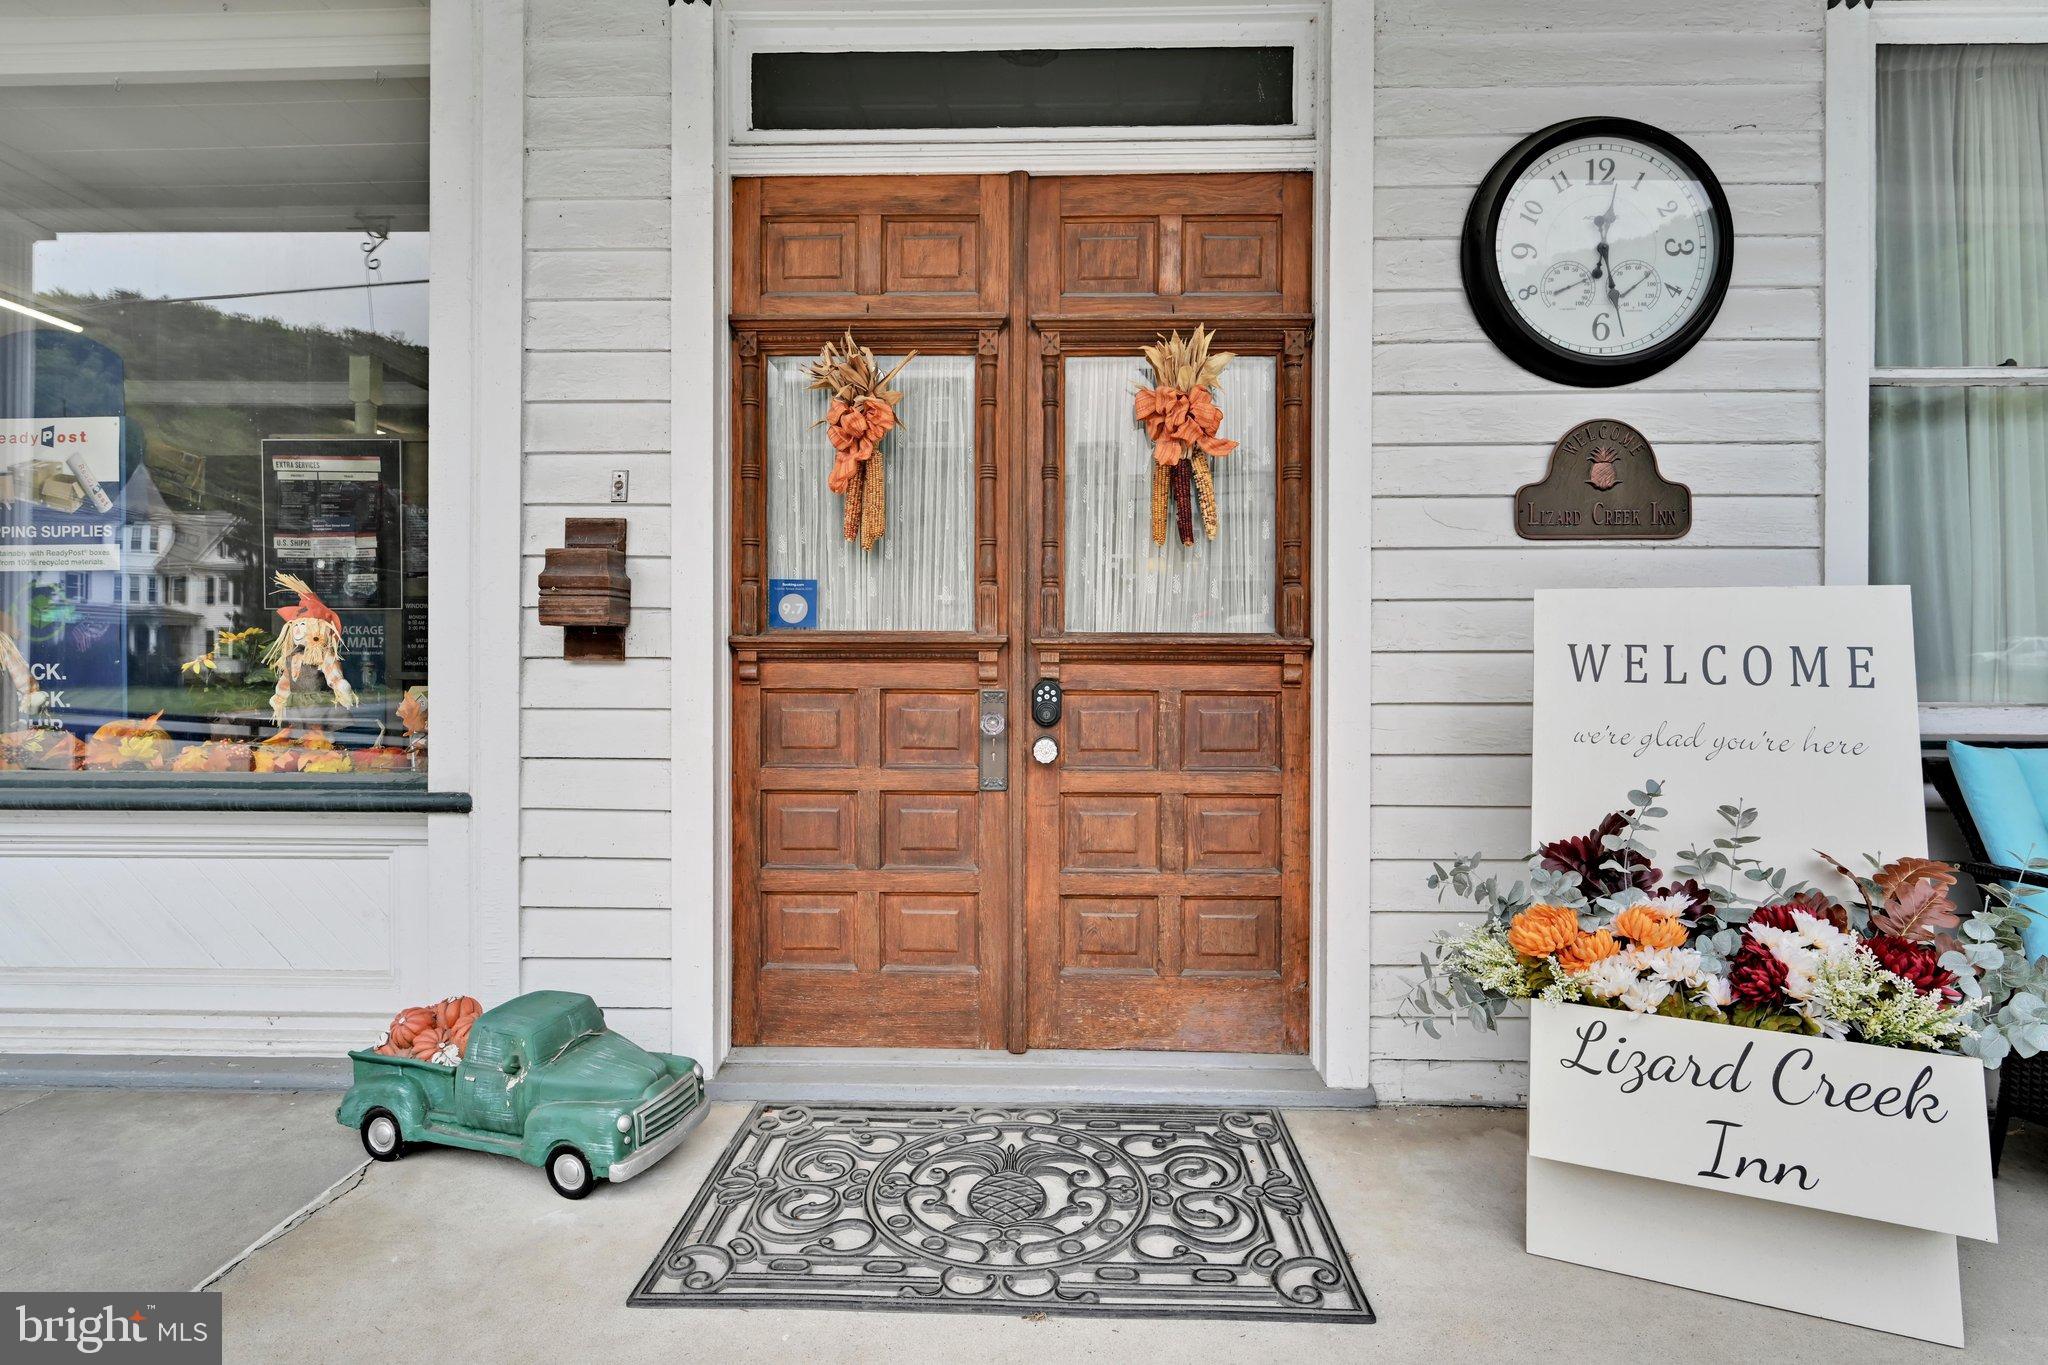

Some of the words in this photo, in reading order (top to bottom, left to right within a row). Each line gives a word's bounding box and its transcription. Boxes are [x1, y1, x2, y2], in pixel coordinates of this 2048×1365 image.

[1585, 157, 1616, 186] 12
[1549, 170, 1573, 194] 11
[1630, 171, 1646, 191] 1
[1519, 200, 1543, 226] 10
[1656, 200, 1678, 218] 2
[1511, 242, 1538, 260] 9
[1664, 238, 1695, 257] 3
[1518, 284, 1538, 301] 8
[1664, 282, 1683, 298] 4
[1591, 312, 1611, 342] 6
[1561, 424, 1646, 458] WELCOME
[275, 461, 293, 469] EXTRA
[295, 461, 321, 470] SERVICES
[0, 525, 37, 538] PING
[41, 525, 113, 538] SUPPLIES
[291, 539, 311, 547] SHIPPI
[29, 549, 45, 557] with
[39, 558, 70, 567] recycled
[783, 603, 804, 615] 9.7
[341, 624, 385, 635] ACKAGE
[347, 636, 385, 648] MAIL?
[1568, 643, 1875, 689] WELCOME
[1573, 724, 1633, 747] we're
[1632, 720, 1706, 759] glad
[1705, 730, 1794, 762] you're
[1803, 725, 1869, 757] here
[1560, 1019, 1751, 1094] Lizard
[1771, 1047, 1949, 1124] Creek
[1697, 1118, 1820, 1191] Inn
